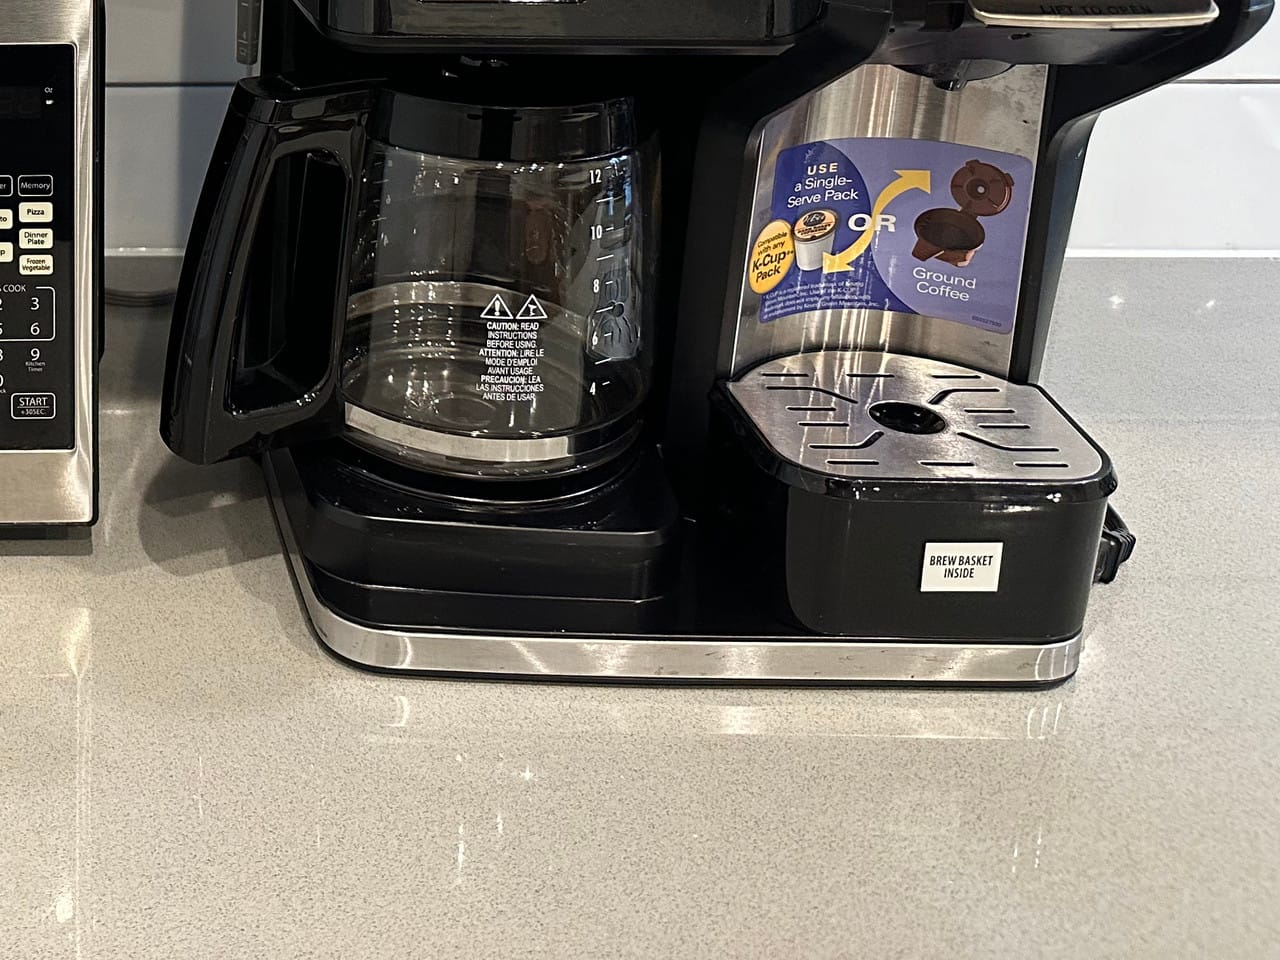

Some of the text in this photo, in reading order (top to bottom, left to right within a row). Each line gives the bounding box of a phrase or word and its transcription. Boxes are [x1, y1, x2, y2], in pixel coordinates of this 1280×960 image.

[807, 162, 839, 175] USE
[589, 169, 602, 184] 12
[20, 182, 51, 191] Memory
[794, 175, 853, 192] a Single-
[787, 188, 859, 208] Serve Pack
[847, 213, 897, 233] OR
[590, 225, 603, 240] 10
[757, 240, 786, 256] with any
[756, 264, 781, 283] Pack
[912, 266, 977, 289] Ground
[3, 285, 27, 293] COOK
[593, 279, 600, 293] 8
[916, 281, 970, 302] Coffee
[30, 297, 40, 310] 3
[30, 322, 40, 336] 6
[486, 321, 539, 330] CAUTION: READ
[487, 331, 538, 339] INSTRUCTIONS
[486, 340, 514, 348] BEFORE
[30, 348, 40, 361] 9
[478, 348, 545, 357] ATTENTION: LIRE LE
[485, 357, 538, 366] MODE D'EMPLOI
[487, 367, 534, 375] AVANT USAGE
[528, 375, 541, 384] LEA
[475, 383, 544, 392] LAS INSTRUCCIONES
[589, 382, 596, 396] 4
[19, 397, 48, 406] START
[482, 392, 505, 400] ANTES
[506, 393, 516, 401] DE
[929, 555, 994, 566] BREW BASKET
[943, 567, 975, 578] INSIDE
